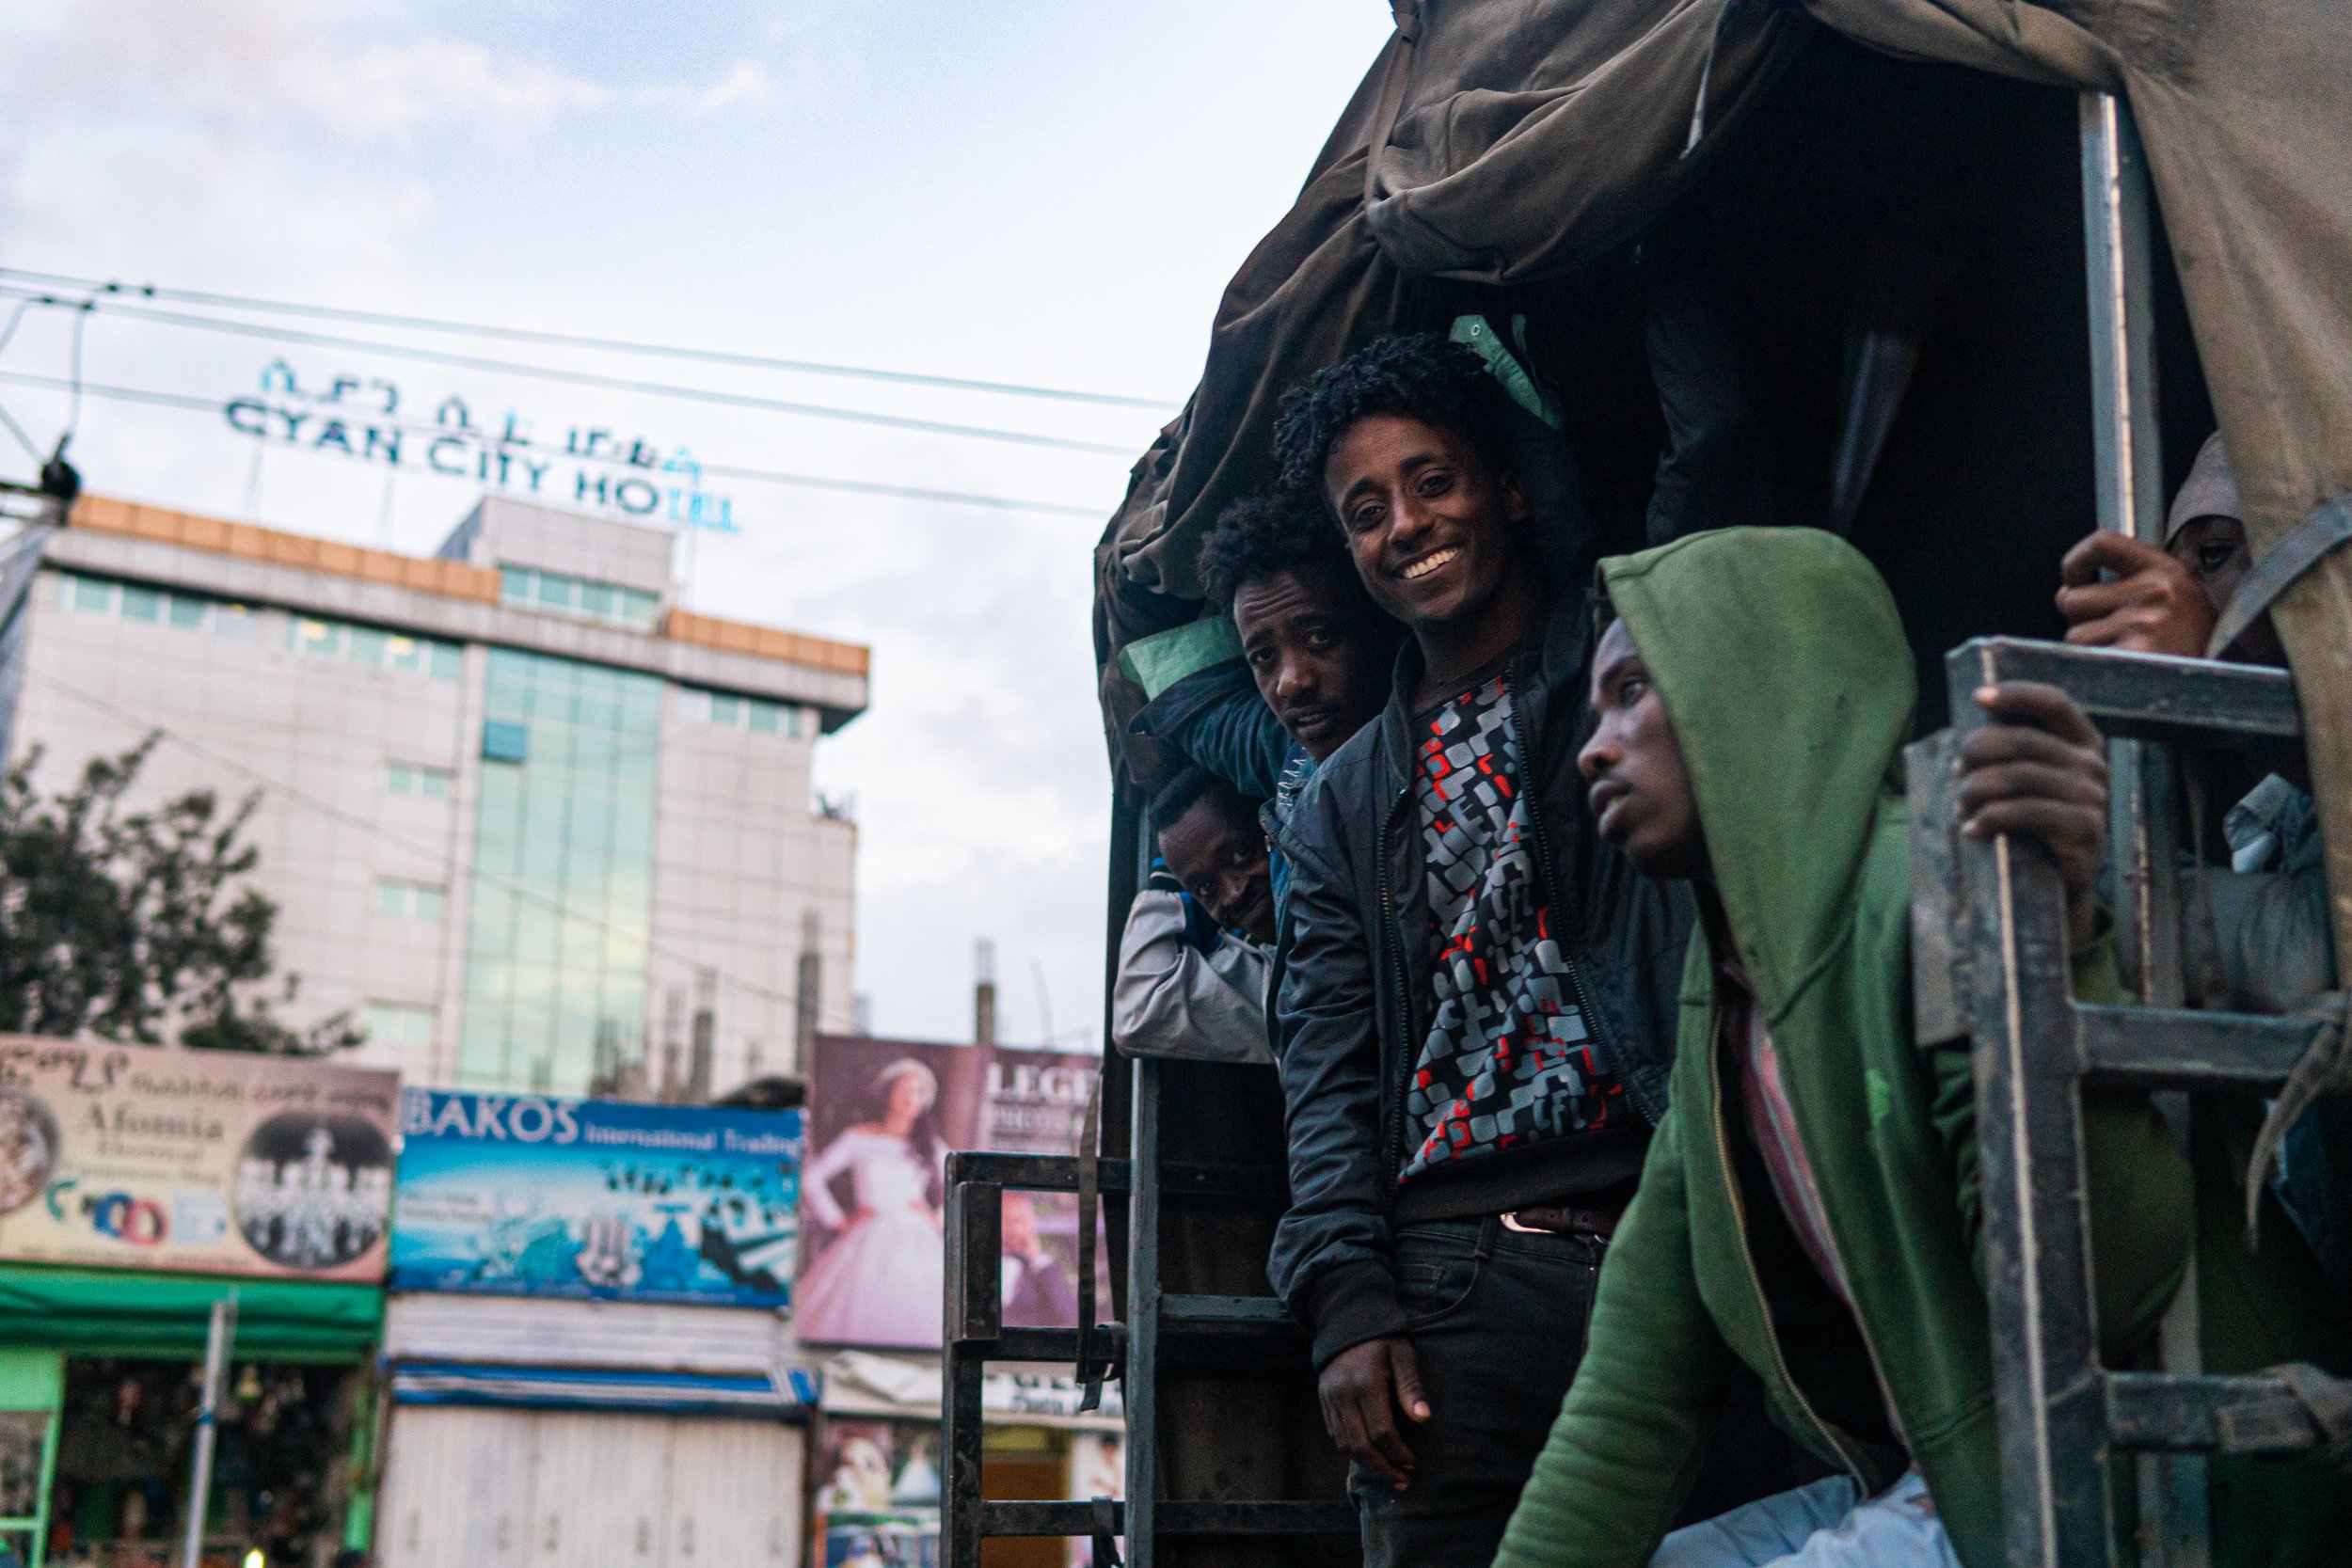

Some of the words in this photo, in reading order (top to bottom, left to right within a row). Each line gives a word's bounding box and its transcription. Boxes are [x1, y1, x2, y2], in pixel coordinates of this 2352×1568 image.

[223, 396, 403, 467] CYAN
[427, 436, 552, 491] CITY
[575, 467, 743, 533] HOTEL
[403, 1091, 580, 1144] BAKOS
